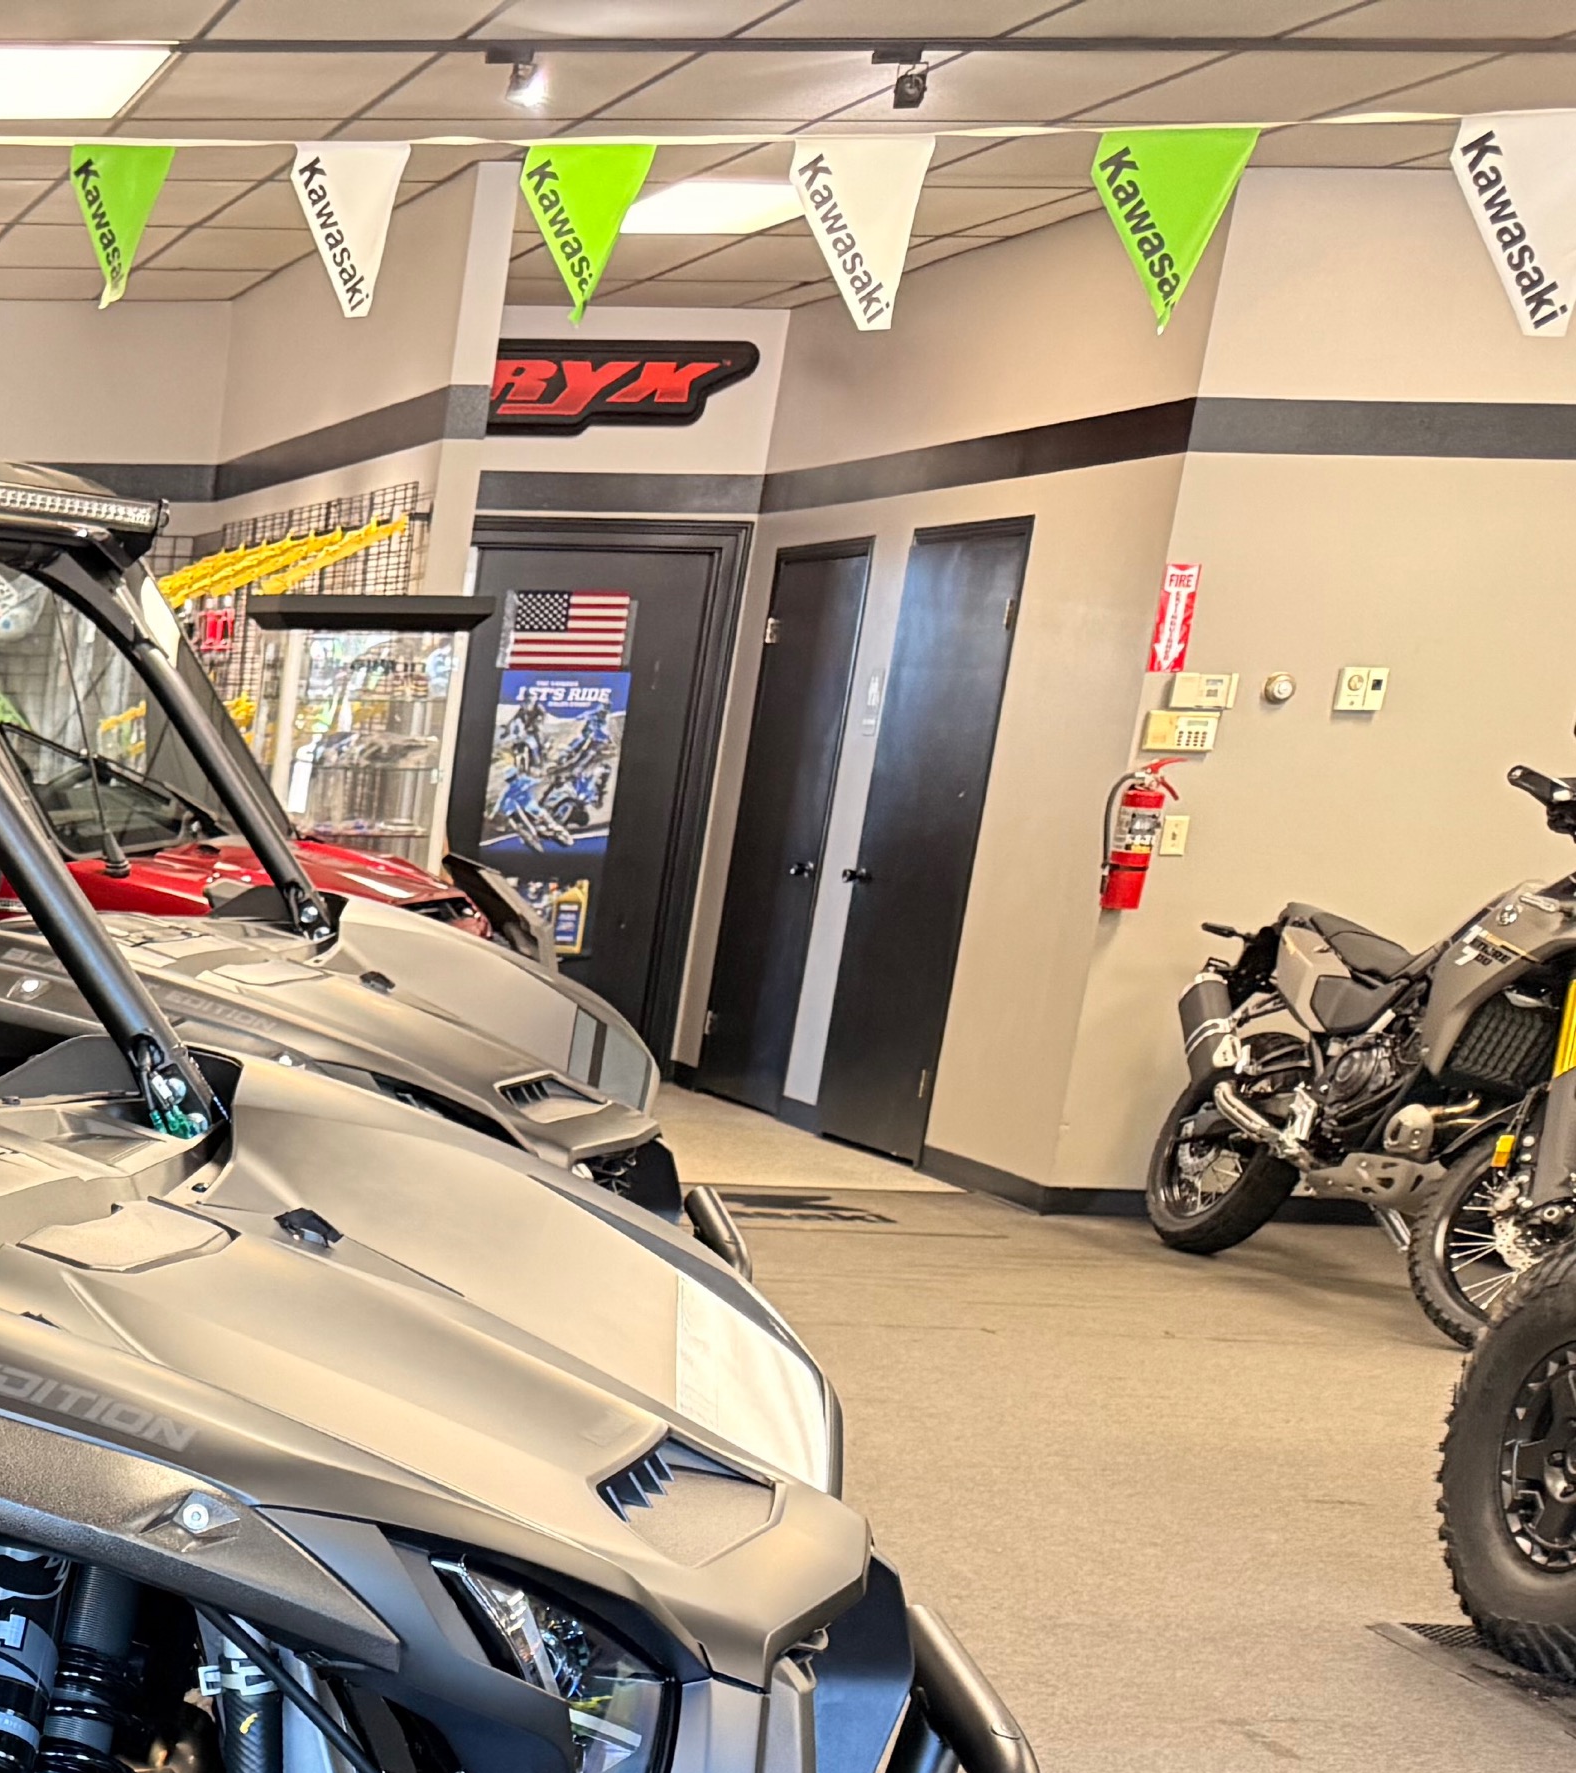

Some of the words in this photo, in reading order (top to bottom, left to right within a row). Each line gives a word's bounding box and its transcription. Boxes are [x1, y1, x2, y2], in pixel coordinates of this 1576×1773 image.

[299, 157, 370, 311] Kawasaki
[798, 154, 890, 324] Kawasaki
[1099, 146, 1180, 301] Kawasa
[1460, 130, 1568, 329] Kawasaki
[490, 360, 720, 415] RYX
[1169, 574, 1194, 588] FIRE
[567, 688, 612, 702] RIDE
[164, 990, 277, 1032] EDITION
